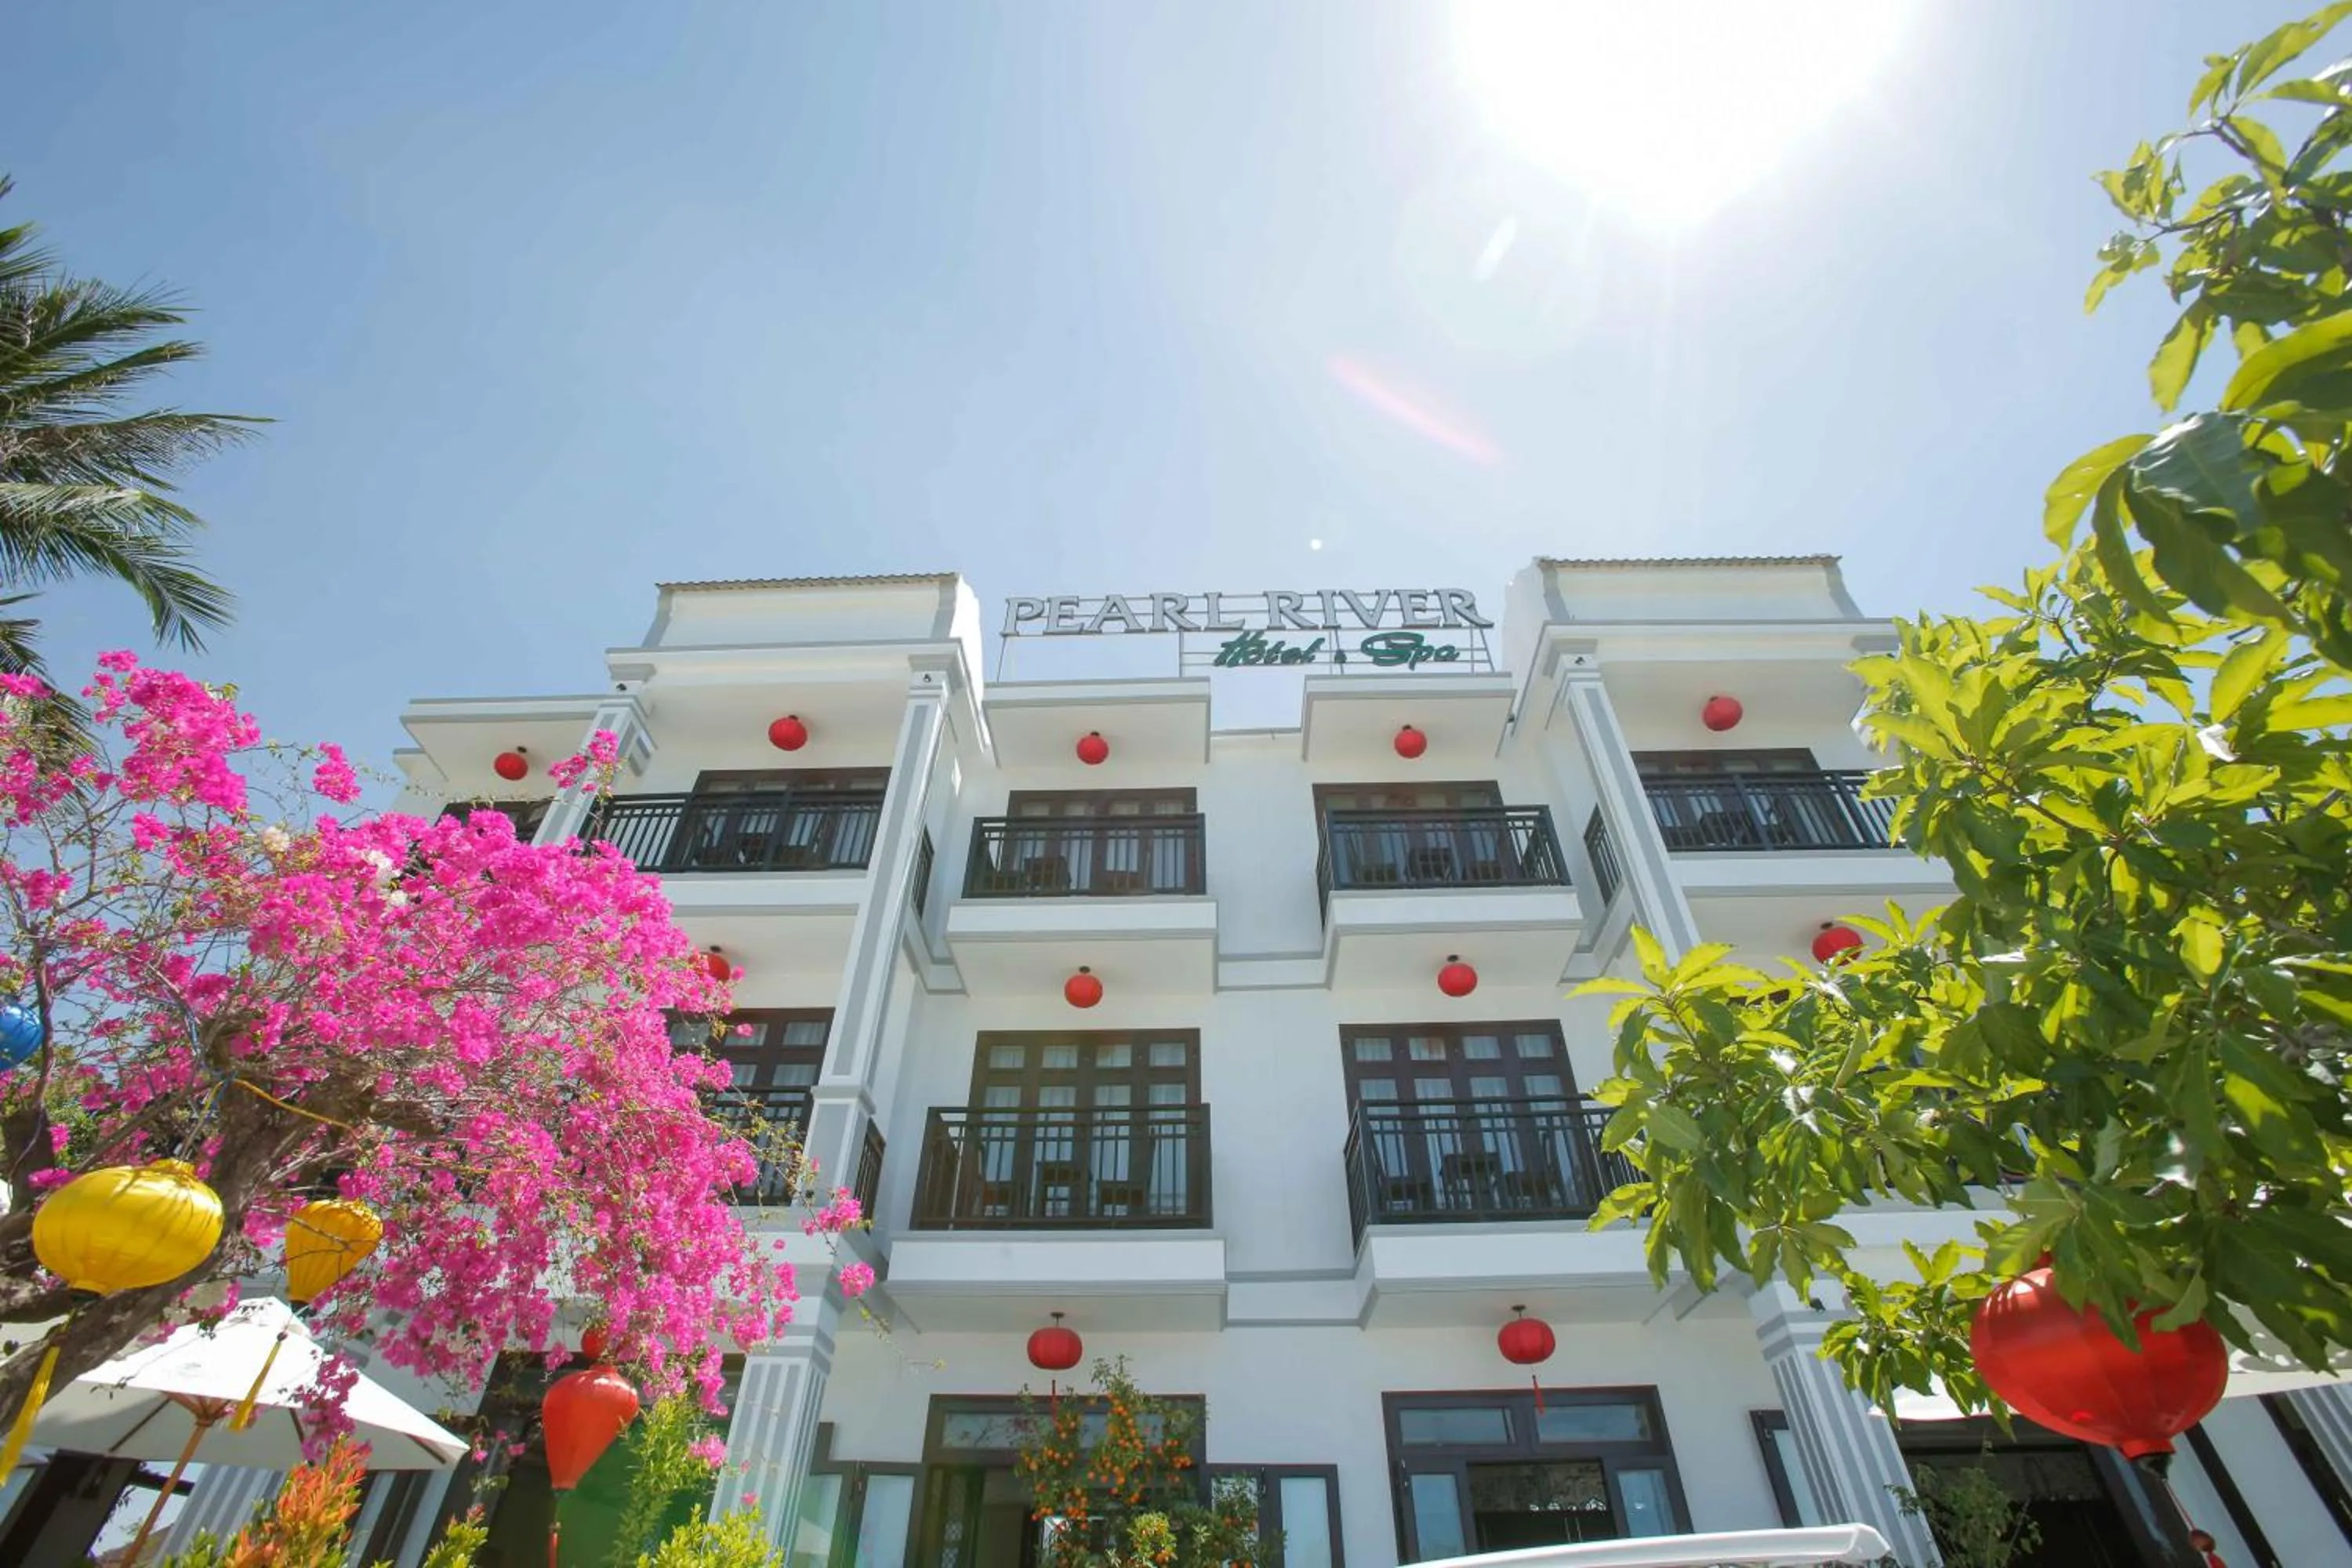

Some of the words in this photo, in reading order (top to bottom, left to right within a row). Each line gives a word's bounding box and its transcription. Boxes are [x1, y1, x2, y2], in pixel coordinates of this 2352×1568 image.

[1000, 592, 1245, 636] PEARL
[1263, 588, 1494, 630] RIVER
[1214, 630, 1325, 668] Hotel
[1361, 631, 1460, 670] Spa
